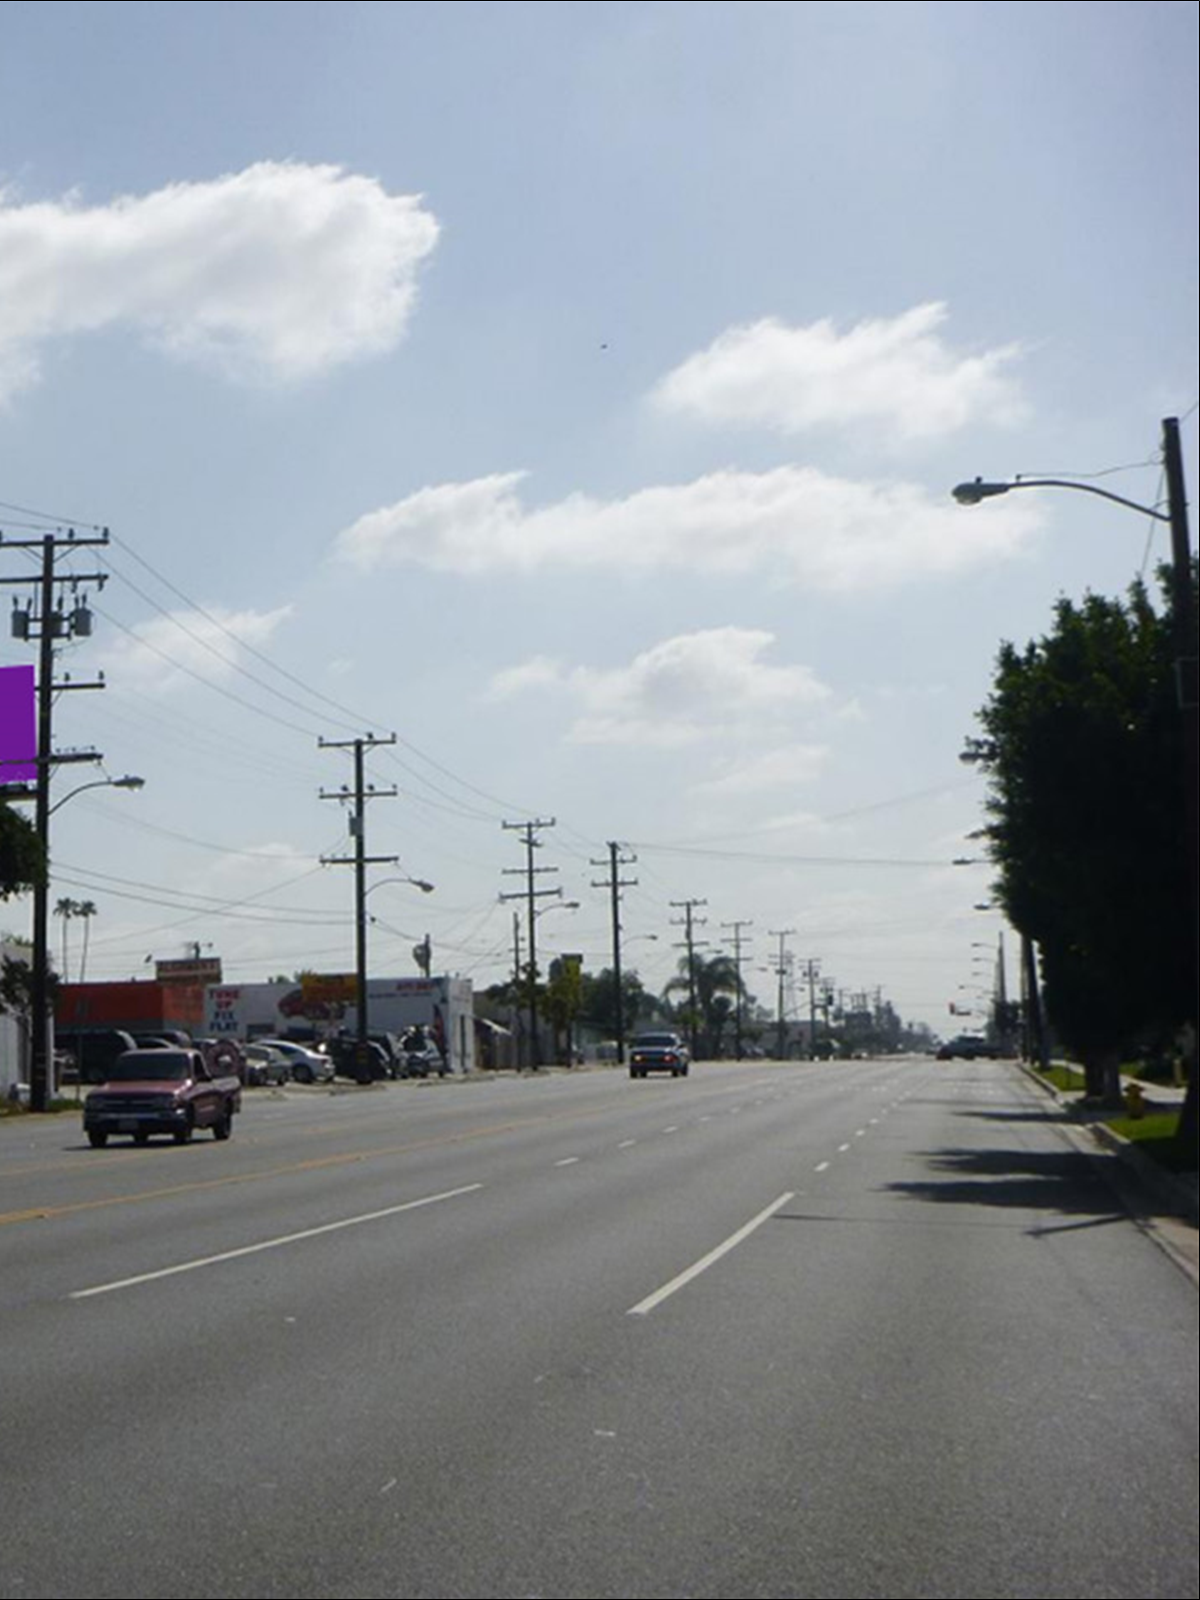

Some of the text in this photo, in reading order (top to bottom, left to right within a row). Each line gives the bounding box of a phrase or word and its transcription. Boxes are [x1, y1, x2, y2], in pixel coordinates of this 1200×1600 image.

[209, 989, 240, 999] TUNE
[215, 1000, 233, 1010] UP
[214, 1011, 235, 1020] FIX
[209, 1021, 239, 1032] FLAT
